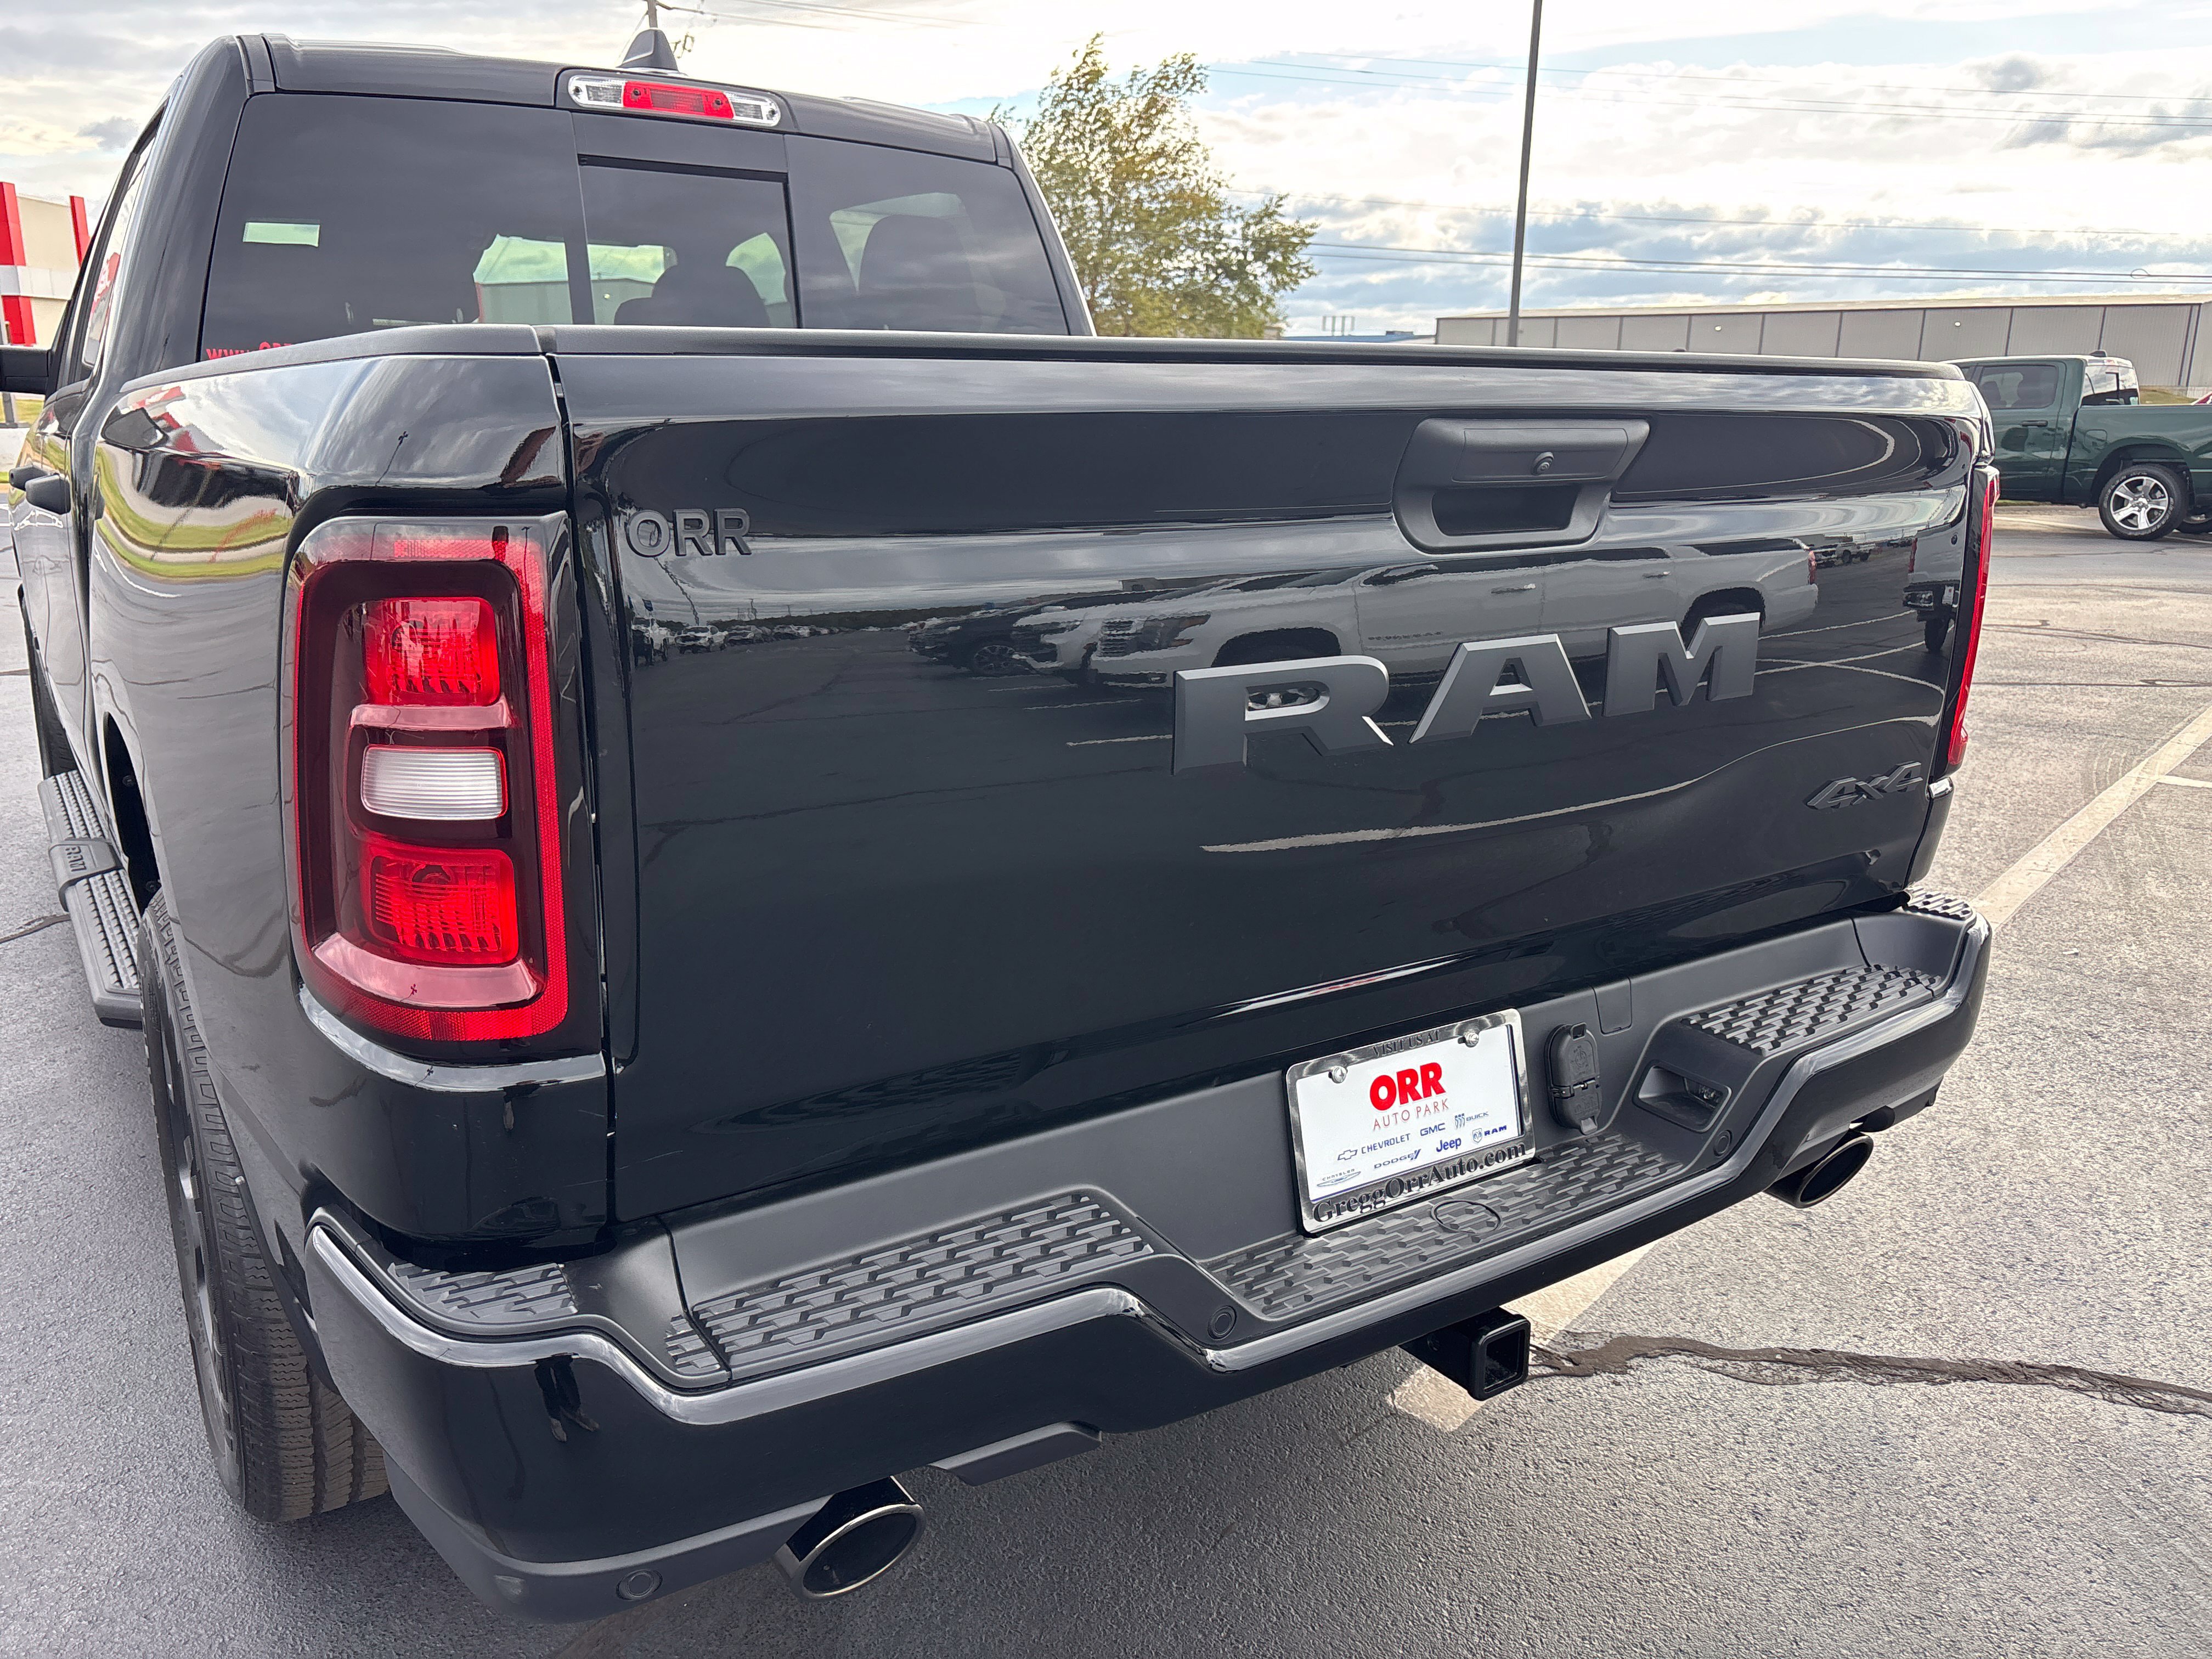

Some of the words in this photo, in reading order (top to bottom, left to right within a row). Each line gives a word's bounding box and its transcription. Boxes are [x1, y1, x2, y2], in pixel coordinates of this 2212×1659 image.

[625, 507, 752, 558] ORR
[1171, 611, 1762, 776] RAM
[65, 846, 87, 872] RAM
[1372, 1039, 1404, 1057] VISIT
[1407, 1034, 1424, 1049] US
[1370, 1062, 1446, 1110] ORR
[1373, 1110, 1410, 1131] AUTO
[1415, 1098, 1449, 1119] PARK
[1466, 1111, 1489, 1122] BUICK
[1420, 1122, 1446, 1137] GMC
[1483, 1125, 1507, 1137] RAM
[1361, 1133, 1411, 1155] CHEVROLET
[1436, 1137, 1462, 1153] Jeep
[1374, 1154, 1414, 1170] DODGE
[1313, 1143, 1526, 1223] GreggOrrAuto.com
